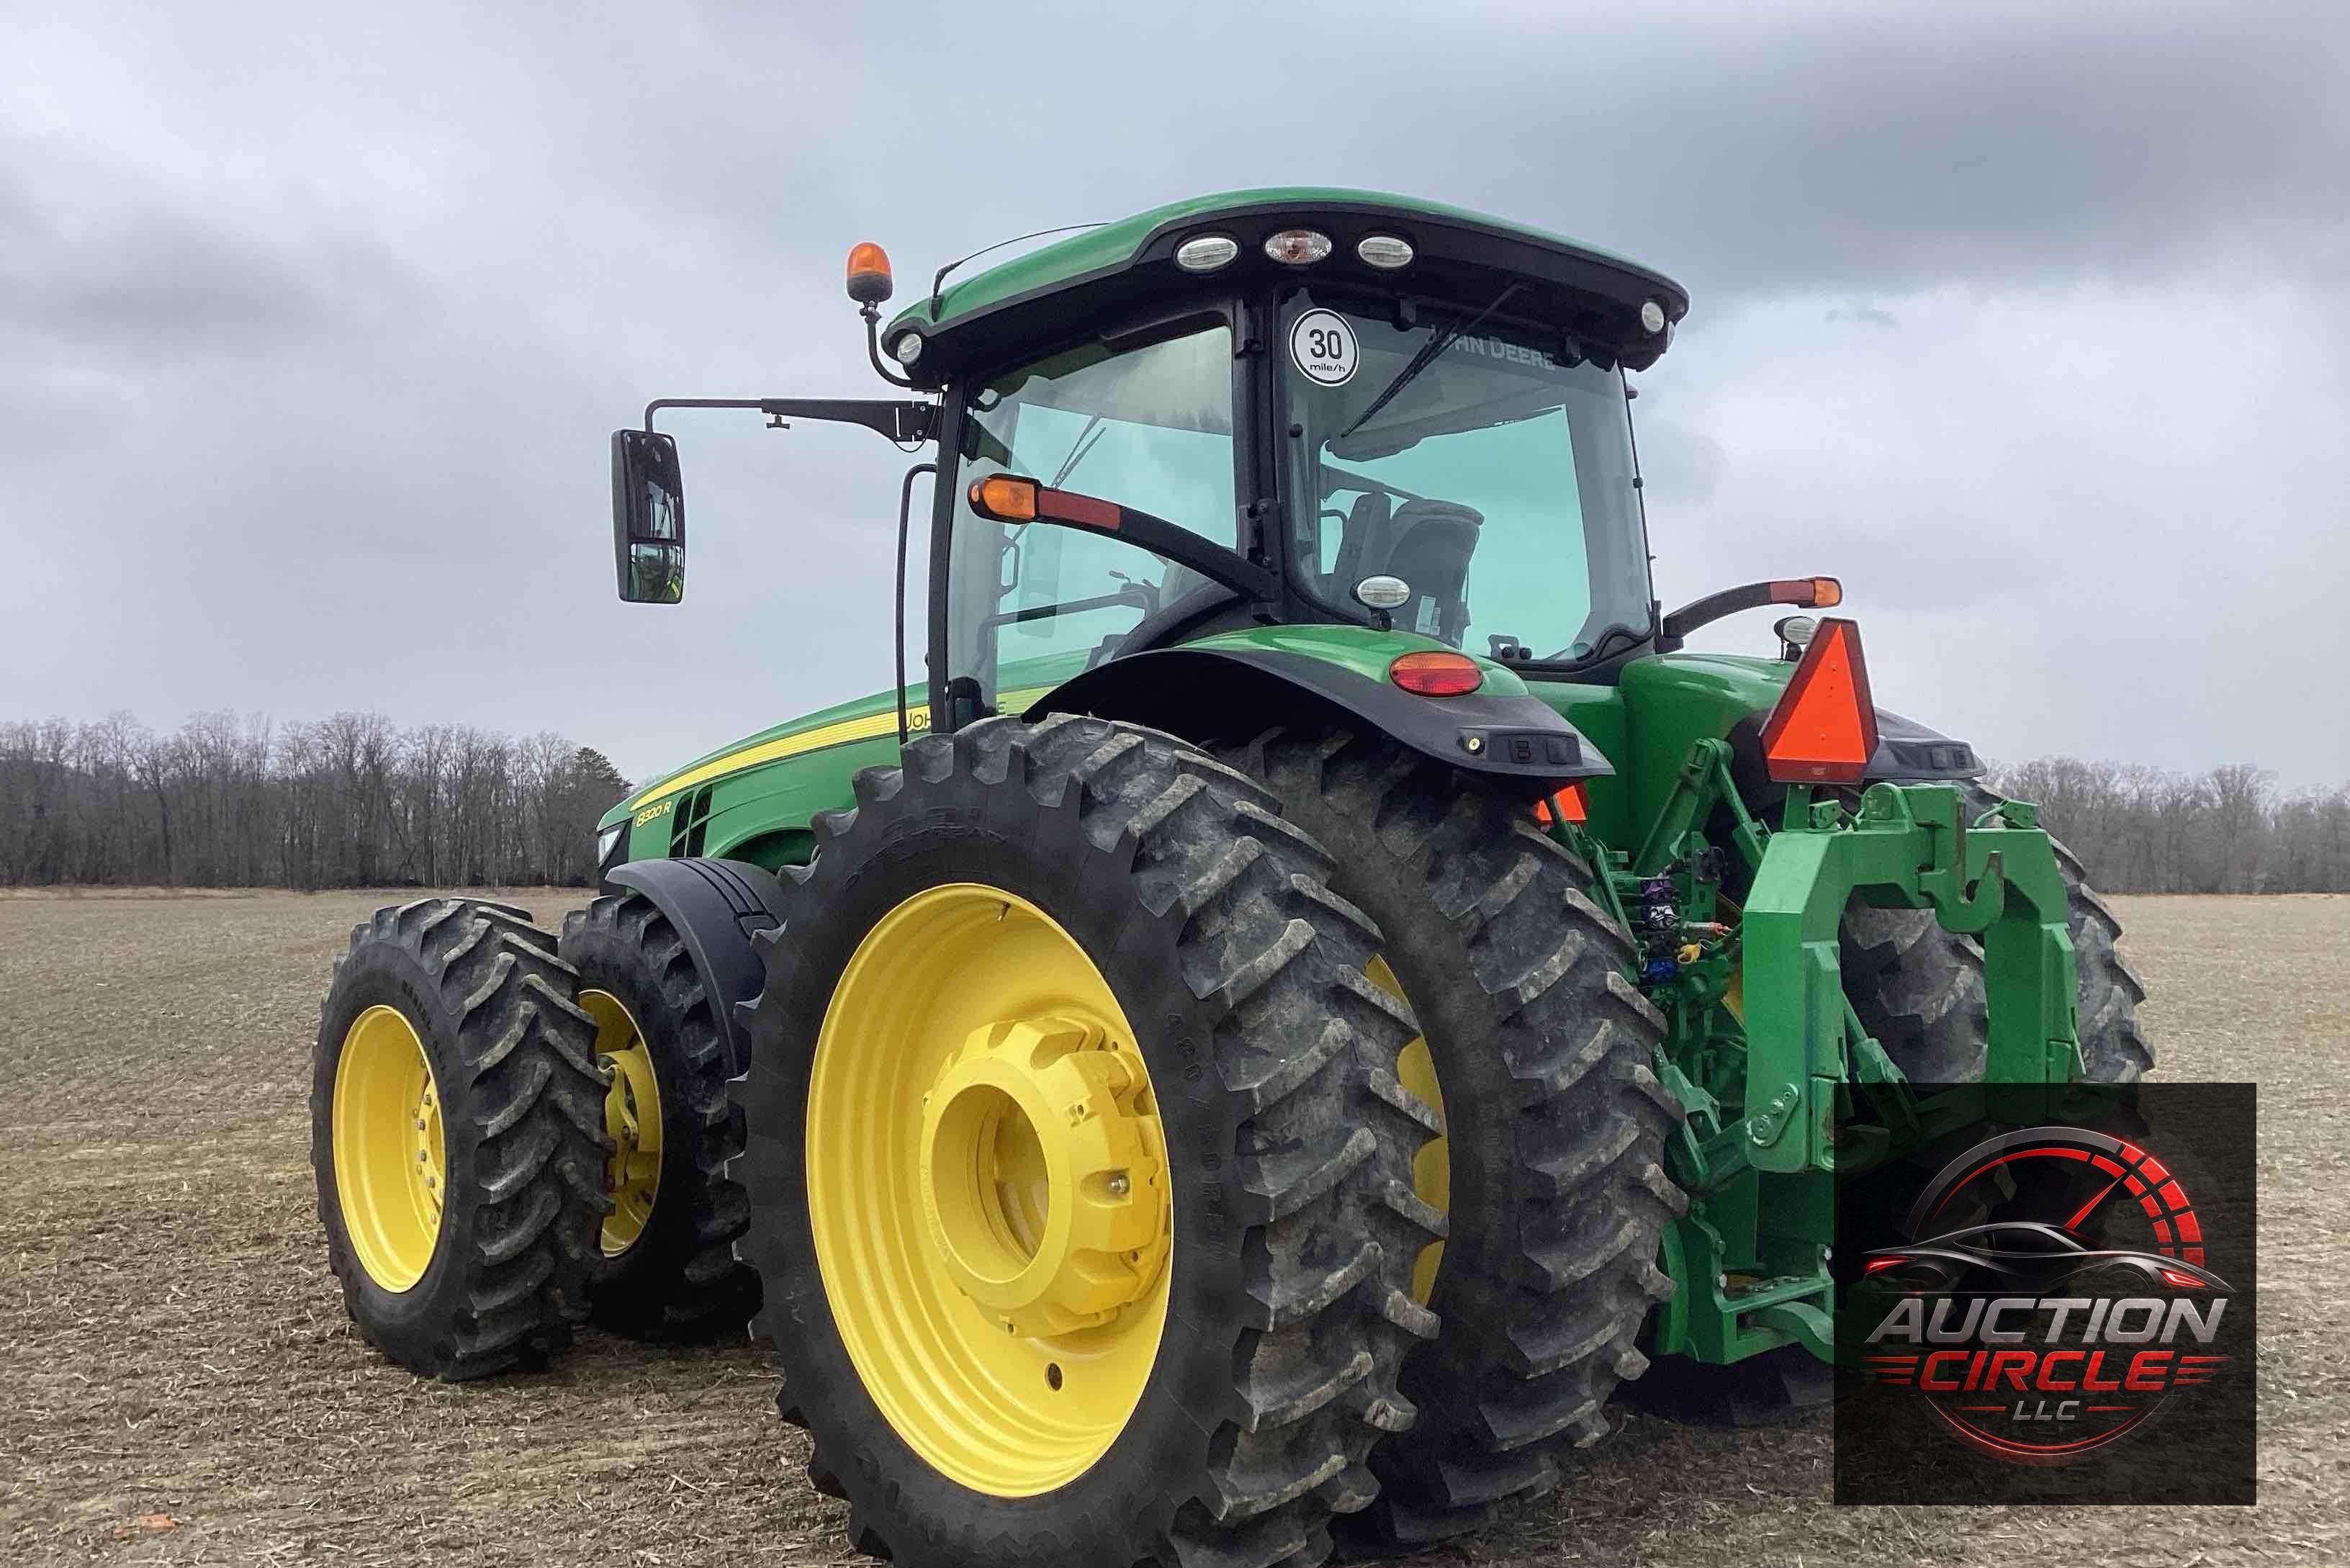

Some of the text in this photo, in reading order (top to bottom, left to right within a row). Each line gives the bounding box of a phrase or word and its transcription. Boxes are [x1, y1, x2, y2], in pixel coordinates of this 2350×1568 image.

[1309, 328, 1343, 360] 30
[1487, 334, 1556, 371] DEERE
[1310, 362, 1346, 373] mile/h
[906, 713, 932, 729] JOH
